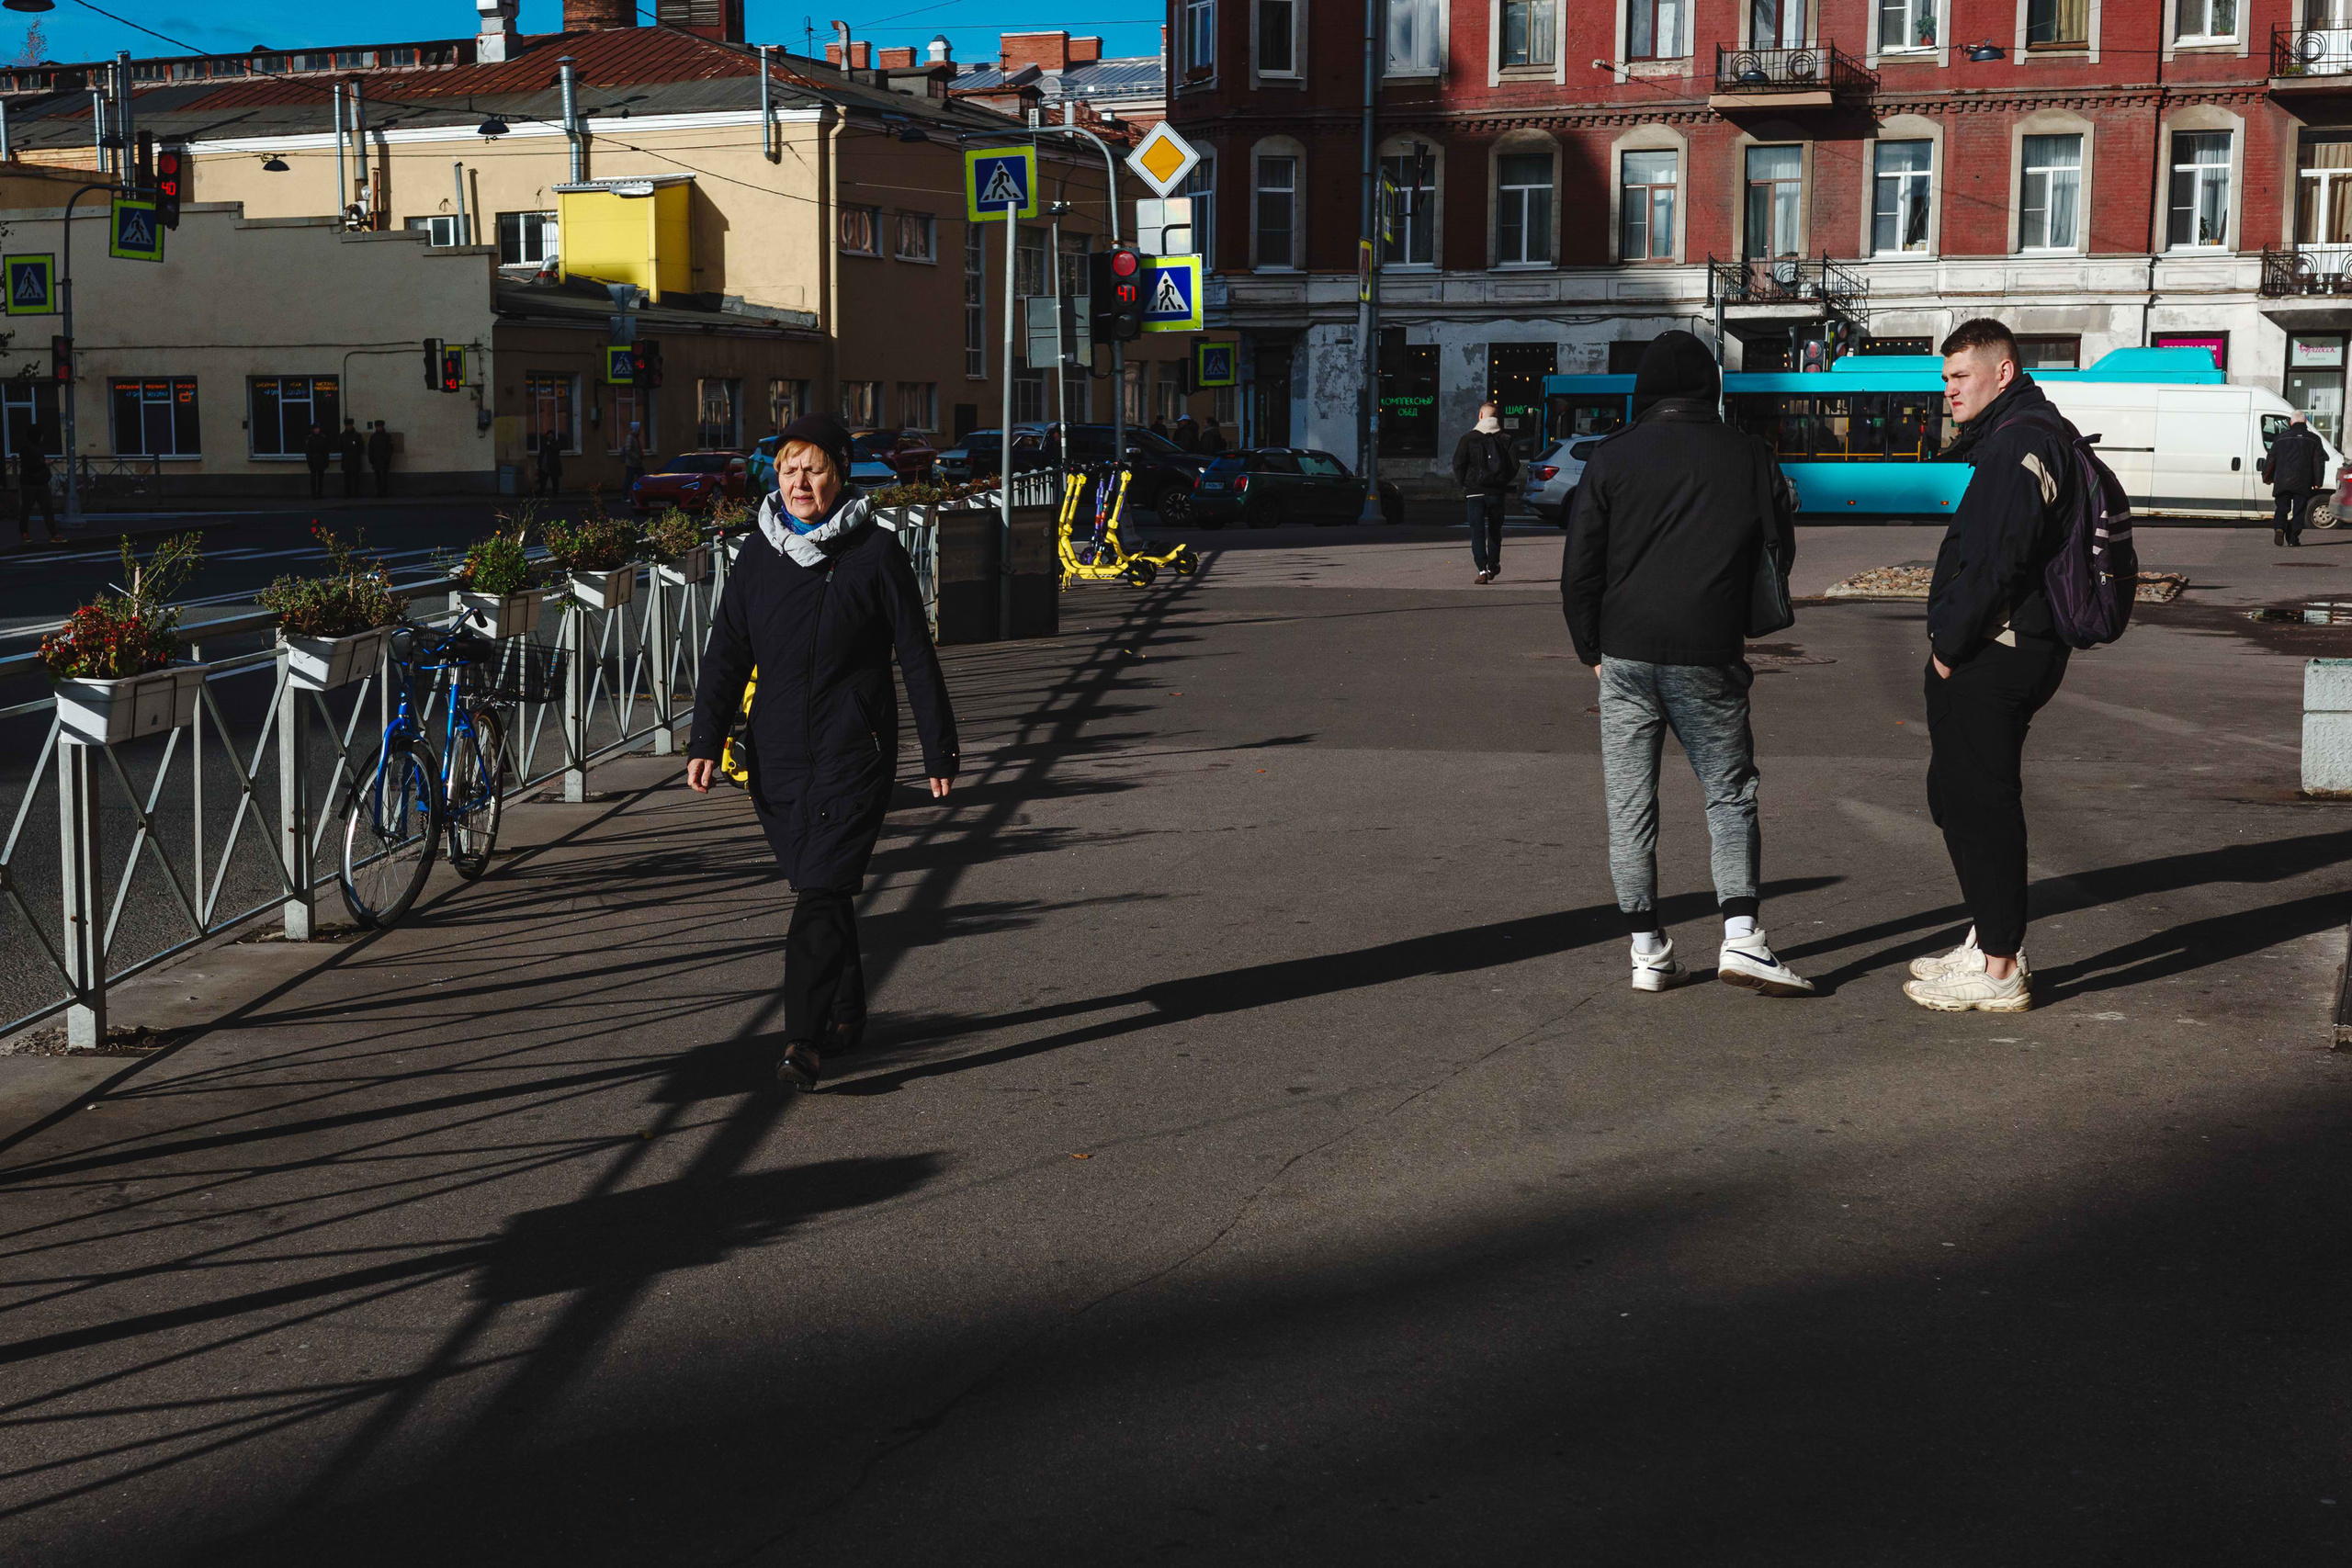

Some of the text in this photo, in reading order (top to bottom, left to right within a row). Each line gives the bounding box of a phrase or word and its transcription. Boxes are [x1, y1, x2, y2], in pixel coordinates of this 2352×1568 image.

[161, 181, 176, 196] 40
[1117, 285, 1136, 301] 41
[446, 378, 458, 389] 40
[1380, 395, 1433, 406] КОМПЛЕКСНЫЙ
[1397, 407, 1418, 417] ОБЕД
